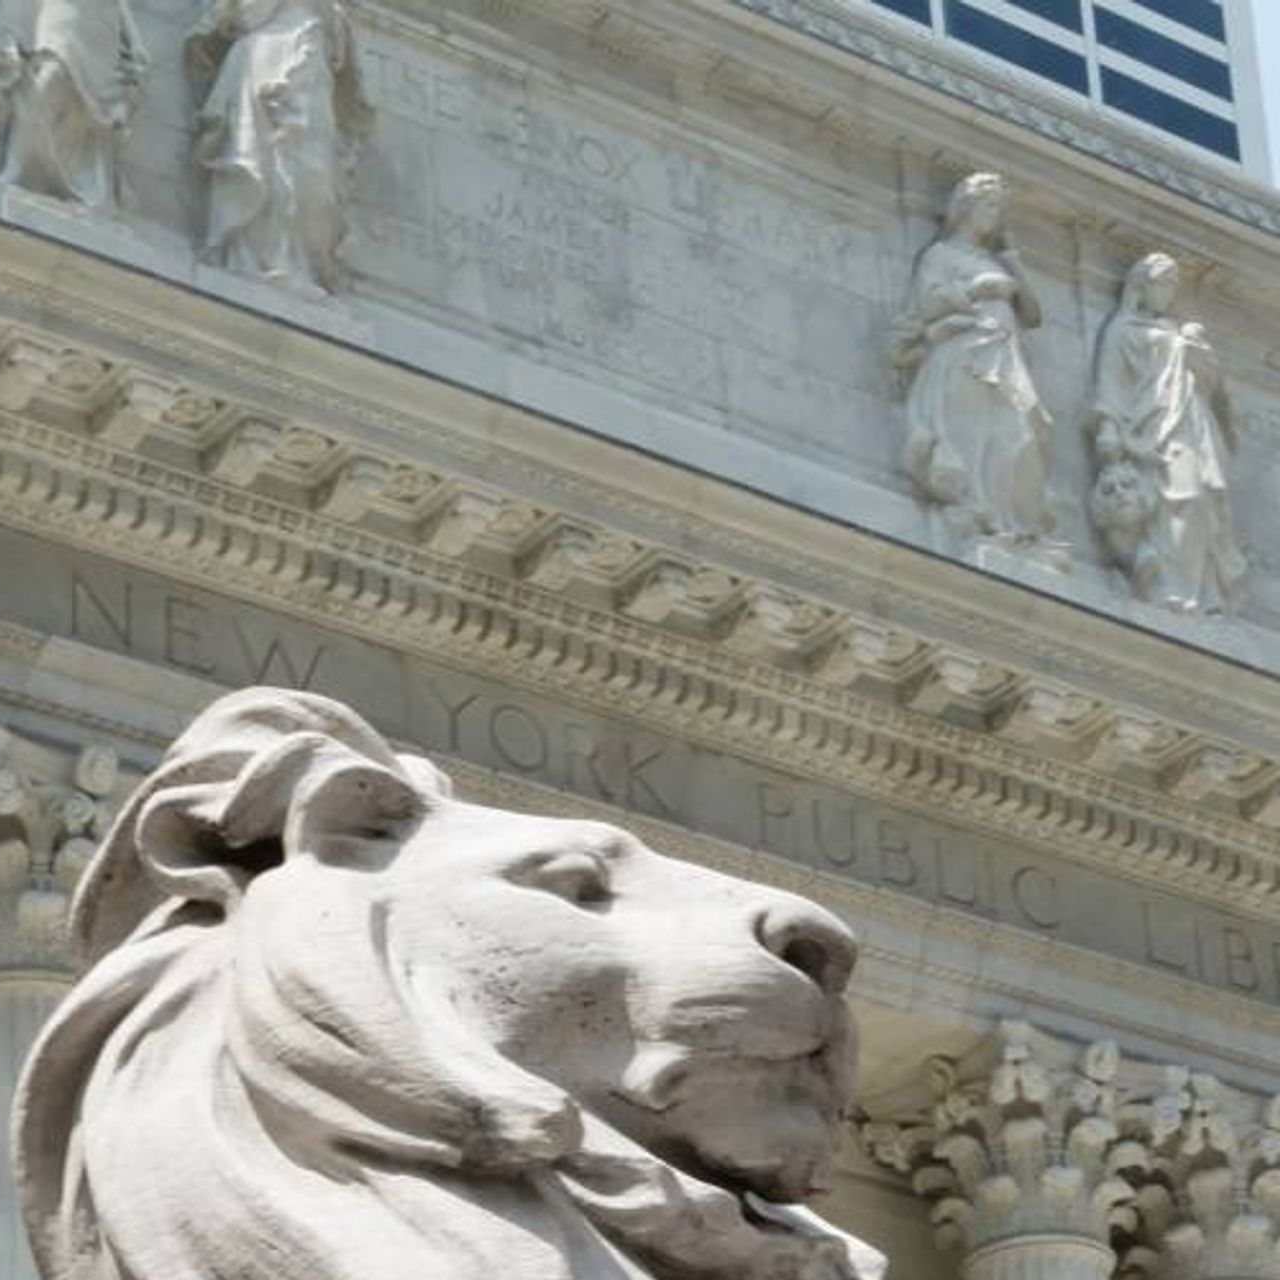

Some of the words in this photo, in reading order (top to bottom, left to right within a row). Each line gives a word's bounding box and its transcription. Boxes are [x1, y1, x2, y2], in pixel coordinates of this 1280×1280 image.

[67, 572, 328, 692] NEW
[431, 686, 672, 814] YORK
[755, 780, 1063, 931] PUBLIC
